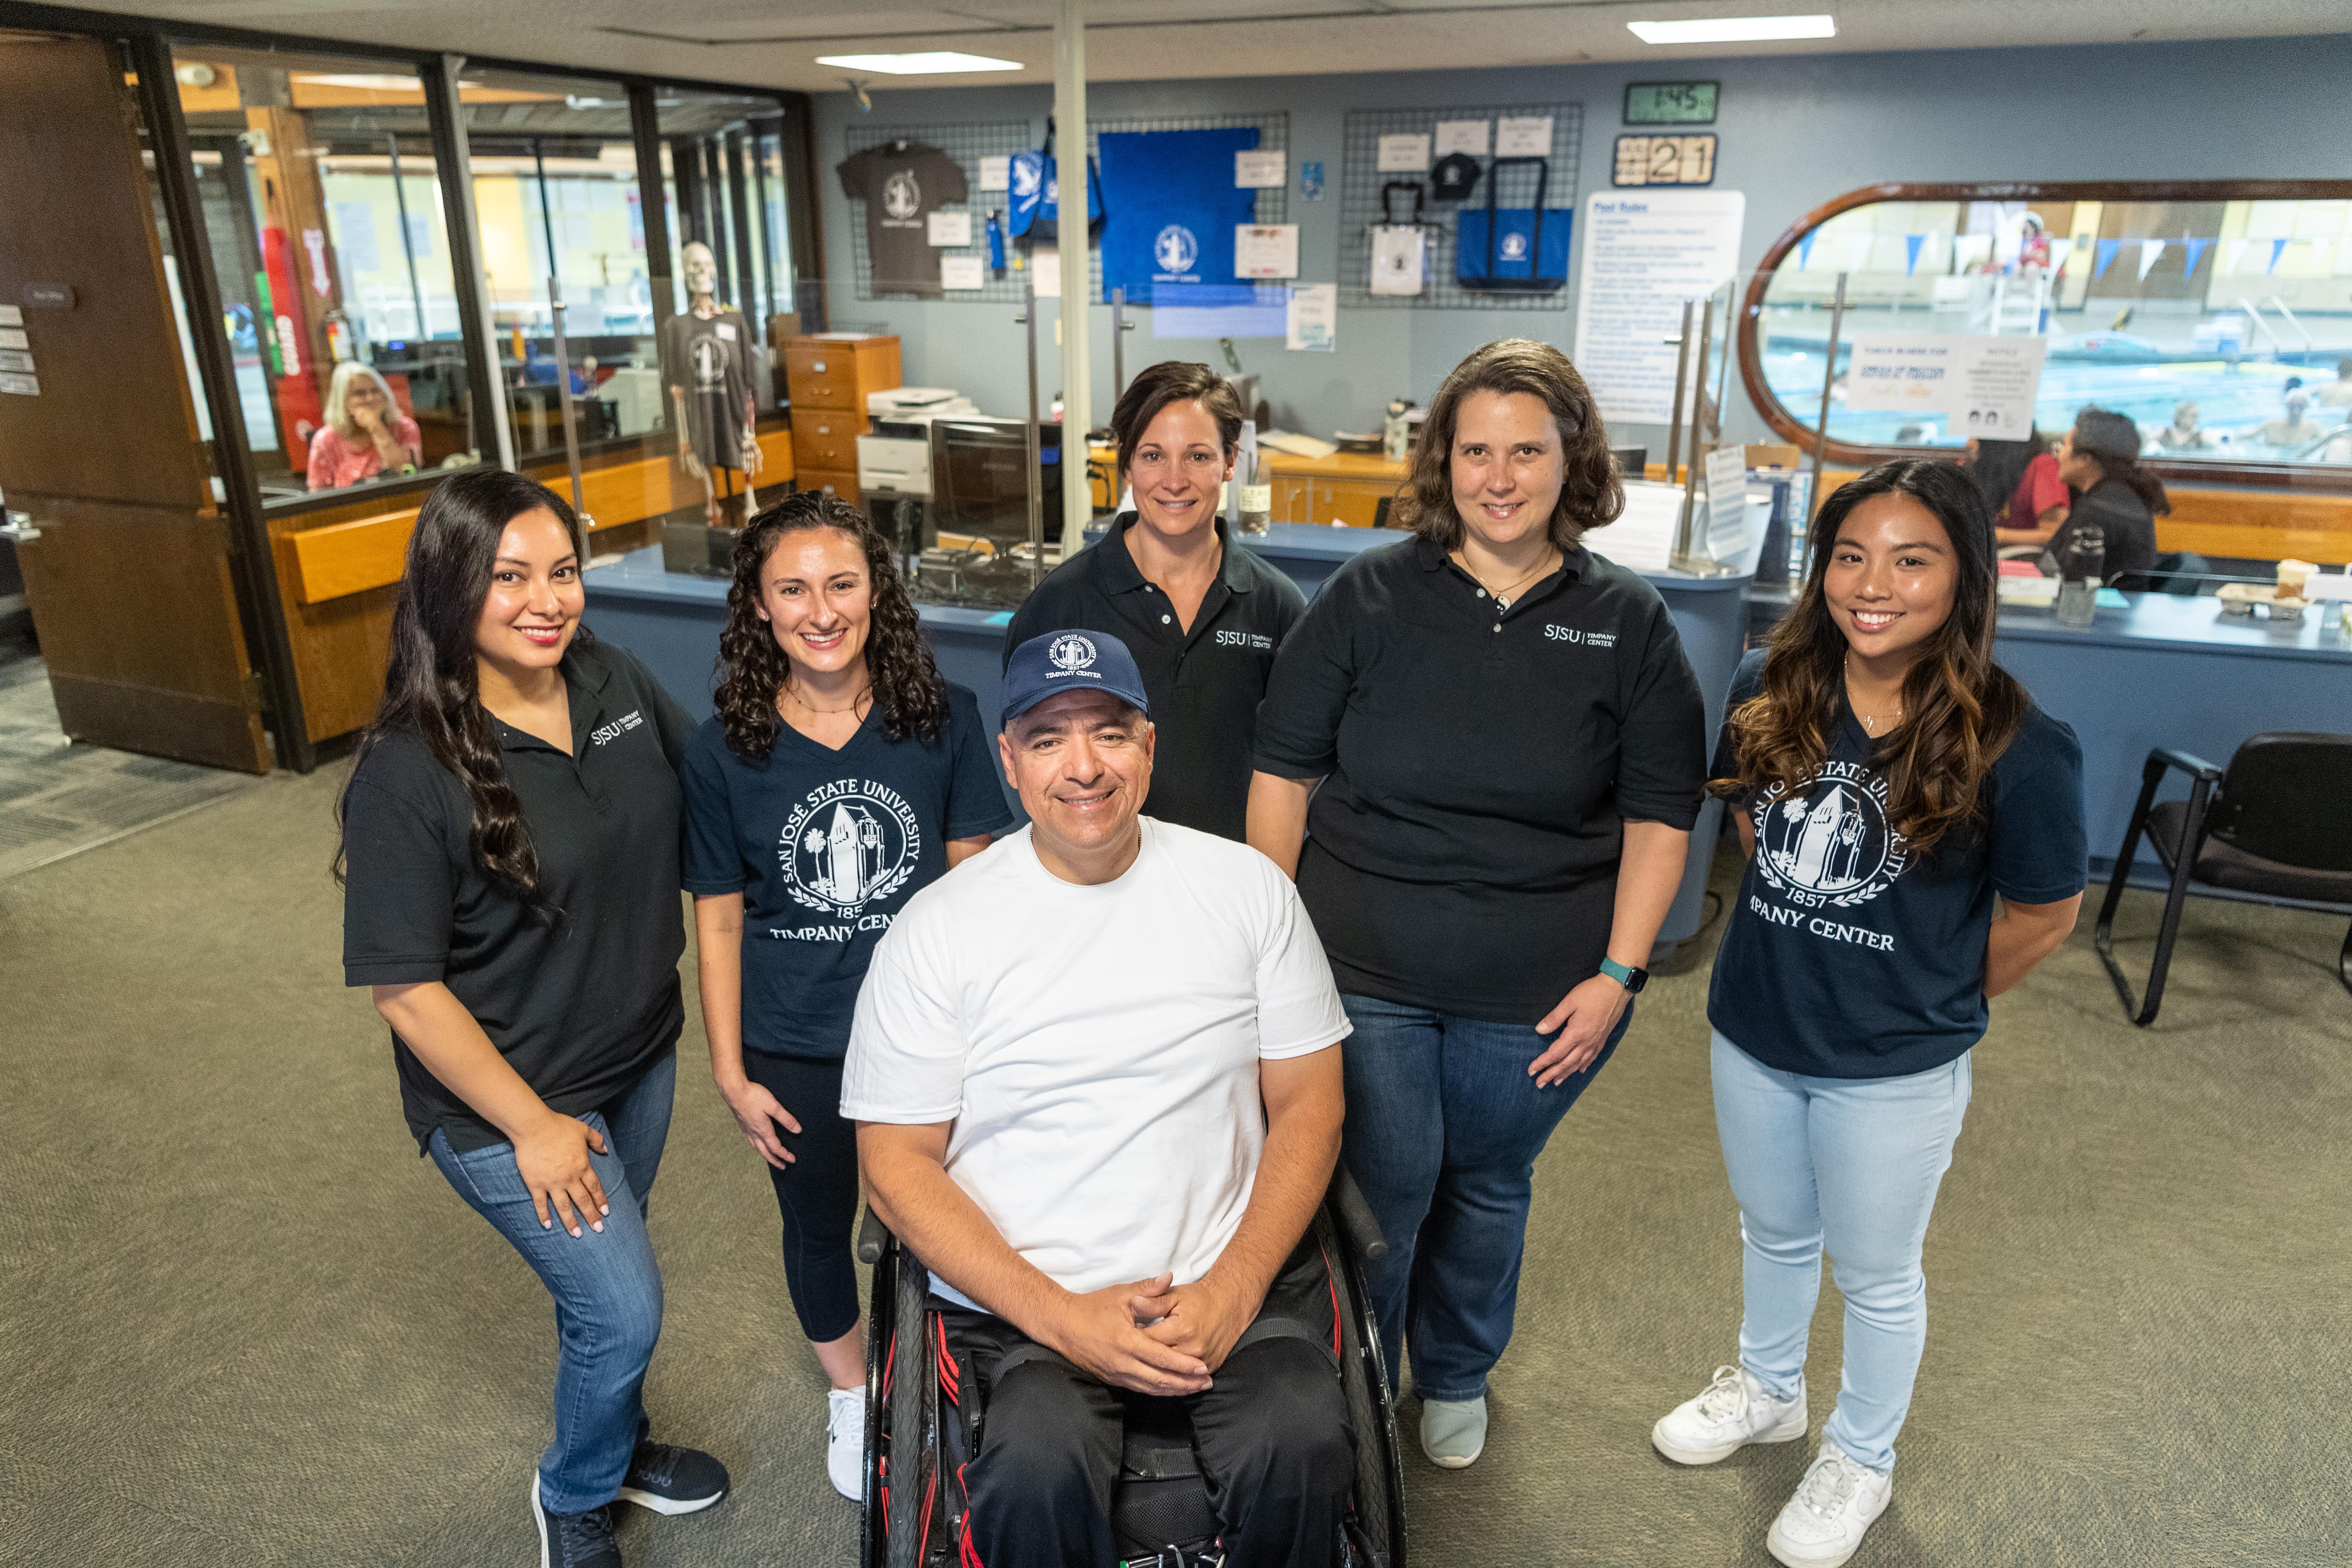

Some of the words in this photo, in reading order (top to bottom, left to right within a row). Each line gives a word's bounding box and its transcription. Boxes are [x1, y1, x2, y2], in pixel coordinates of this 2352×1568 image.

[1216, 630, 1246, 645] SJSU
[1251, 634, 1272, 642] TIMPANY
[1544, 624, 1581, 642] SJSU
[1587, 633, 1616, 641] TIMPANY
[1587, 639, 1613, 647] CENTER
[1078, 635, 1097, 659] UNIVERSITY
[1045, 670, 1075, 679] TIMPANY
[1076, 670, 1102, 679] CENTER
[618, 710, 640, 724] TIMPANY
[625, 717, 643, 730] CENTER
[591, 722, 621, 746] SJSU
[807, 779, 858, 808] STATE
[779, 803, 808, 850] JOSÉ
[863, 779, 920, 861] UNIVERSITY
[1754, 800, 1769, 838] SAN
[778, 850, 794, 883] SAN
[1785, 887, 1827, 909] 1857
[837, 905, 863, 919] 185
[770, 924, 857, 942] TIMPANY
[858, 914, 898, 931] CEN
[1809, 917, 1895, 951] CENTER
